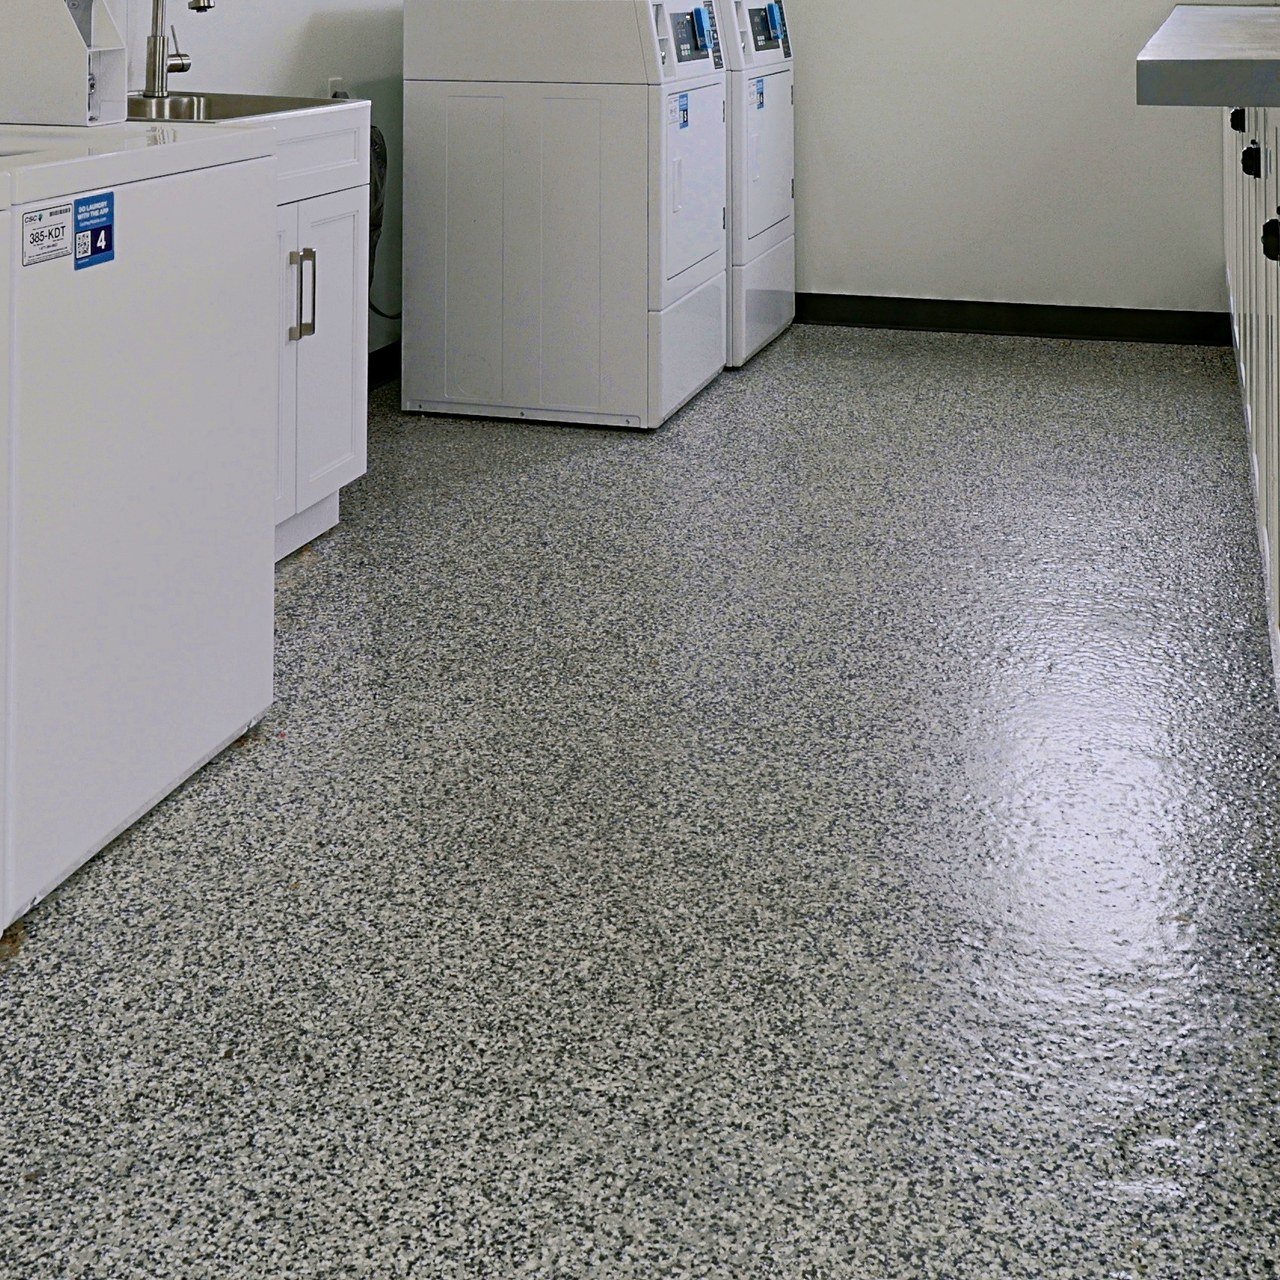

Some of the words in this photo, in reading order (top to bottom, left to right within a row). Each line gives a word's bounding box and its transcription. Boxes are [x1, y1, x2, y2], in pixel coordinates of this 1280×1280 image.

[86, 200, 108, 210] LAUNDRY
[100, 207, 109, 215] APP
[30, 225, 66, 244] 385-KDT
[96, 229, 107, 249] 4
